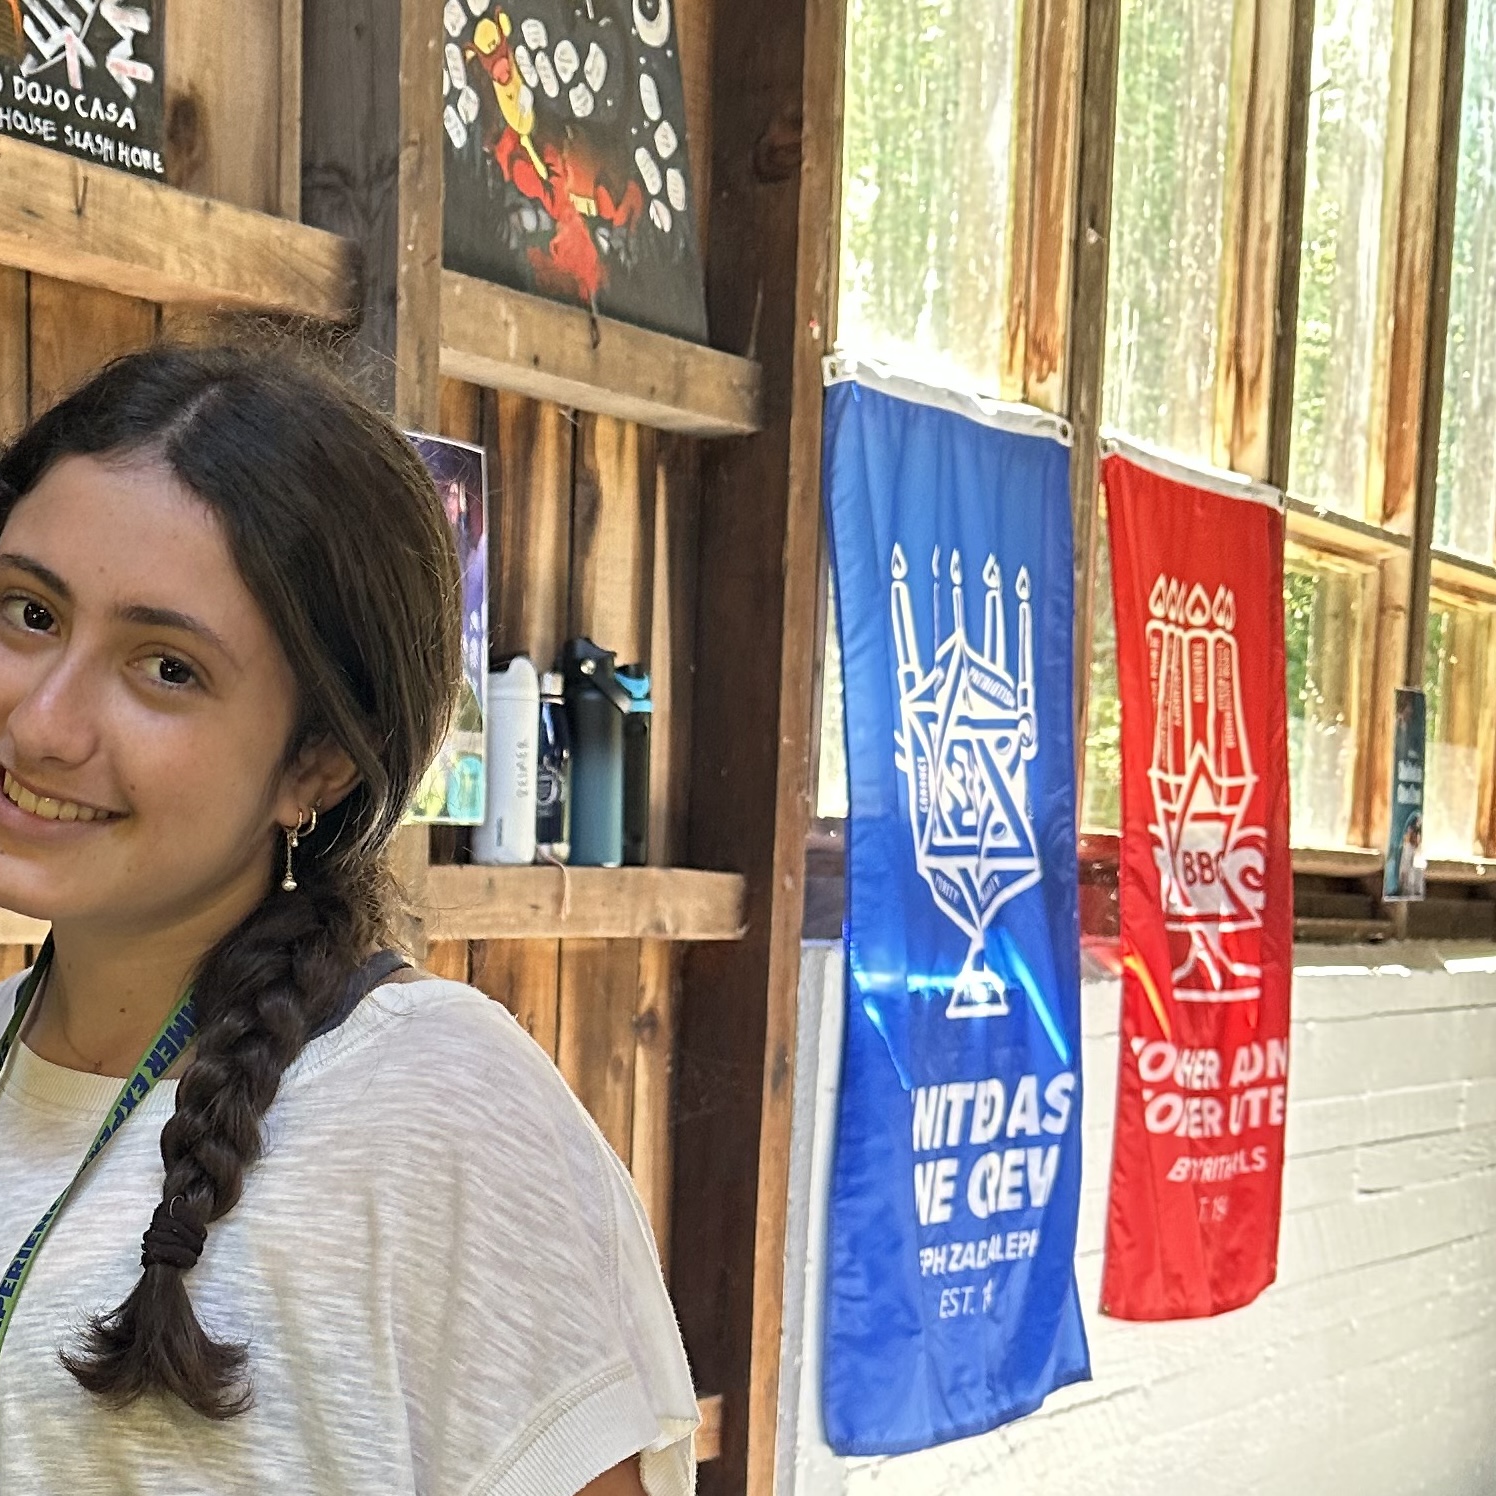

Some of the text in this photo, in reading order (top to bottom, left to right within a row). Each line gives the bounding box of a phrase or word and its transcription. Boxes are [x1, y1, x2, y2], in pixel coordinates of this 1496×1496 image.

[12, 75, 70, 111] DOJO
[75, 98, 136, 130] CASA
[64, 124, 115, 162] SLASH
